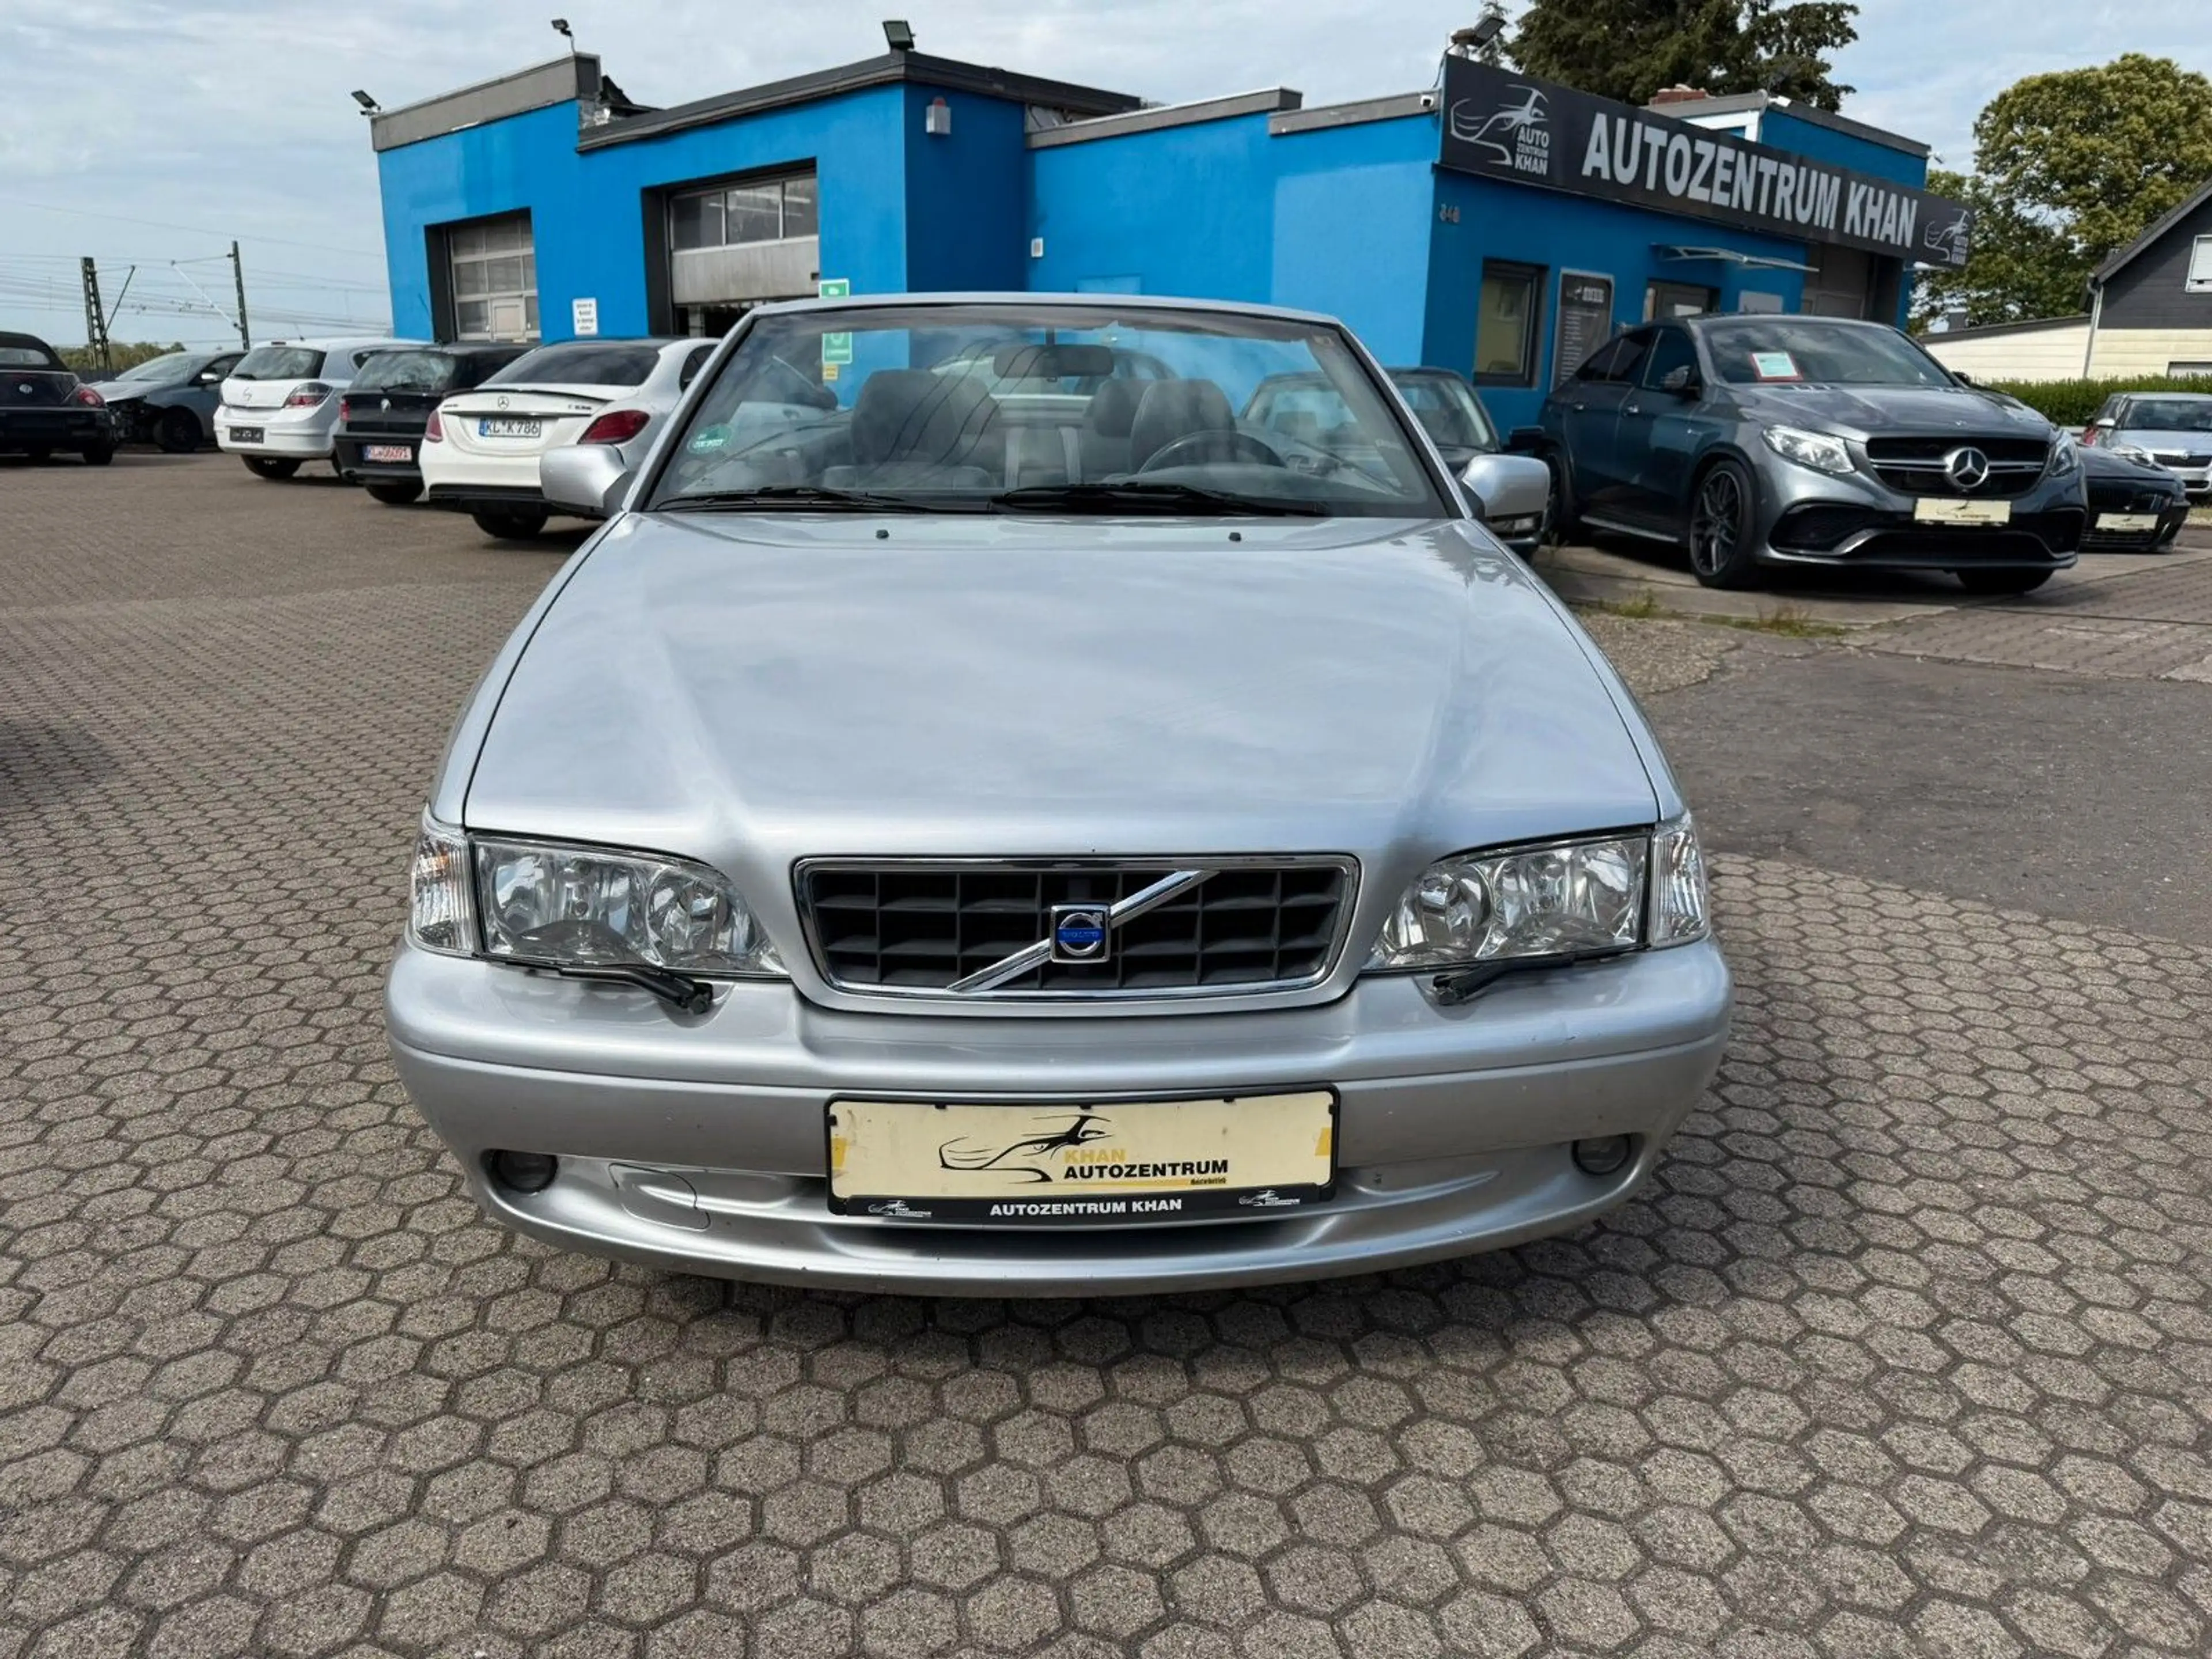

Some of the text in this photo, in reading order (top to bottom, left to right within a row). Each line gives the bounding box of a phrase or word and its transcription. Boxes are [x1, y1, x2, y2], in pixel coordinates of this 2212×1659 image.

[1517, 126, 1550, 147] AUTO
[1514, 153, 1548, 175] KHAN
[1581, 111, 1918, 248] AUTOZENTRUM KHAN
[1065, 1149, 1127, 1163] KHAN
[1064, 1160, 1228, 1179] AUTOZENTRUM
[990, 1199, 1183, 1216] AUTOZENTRUM KHAN
